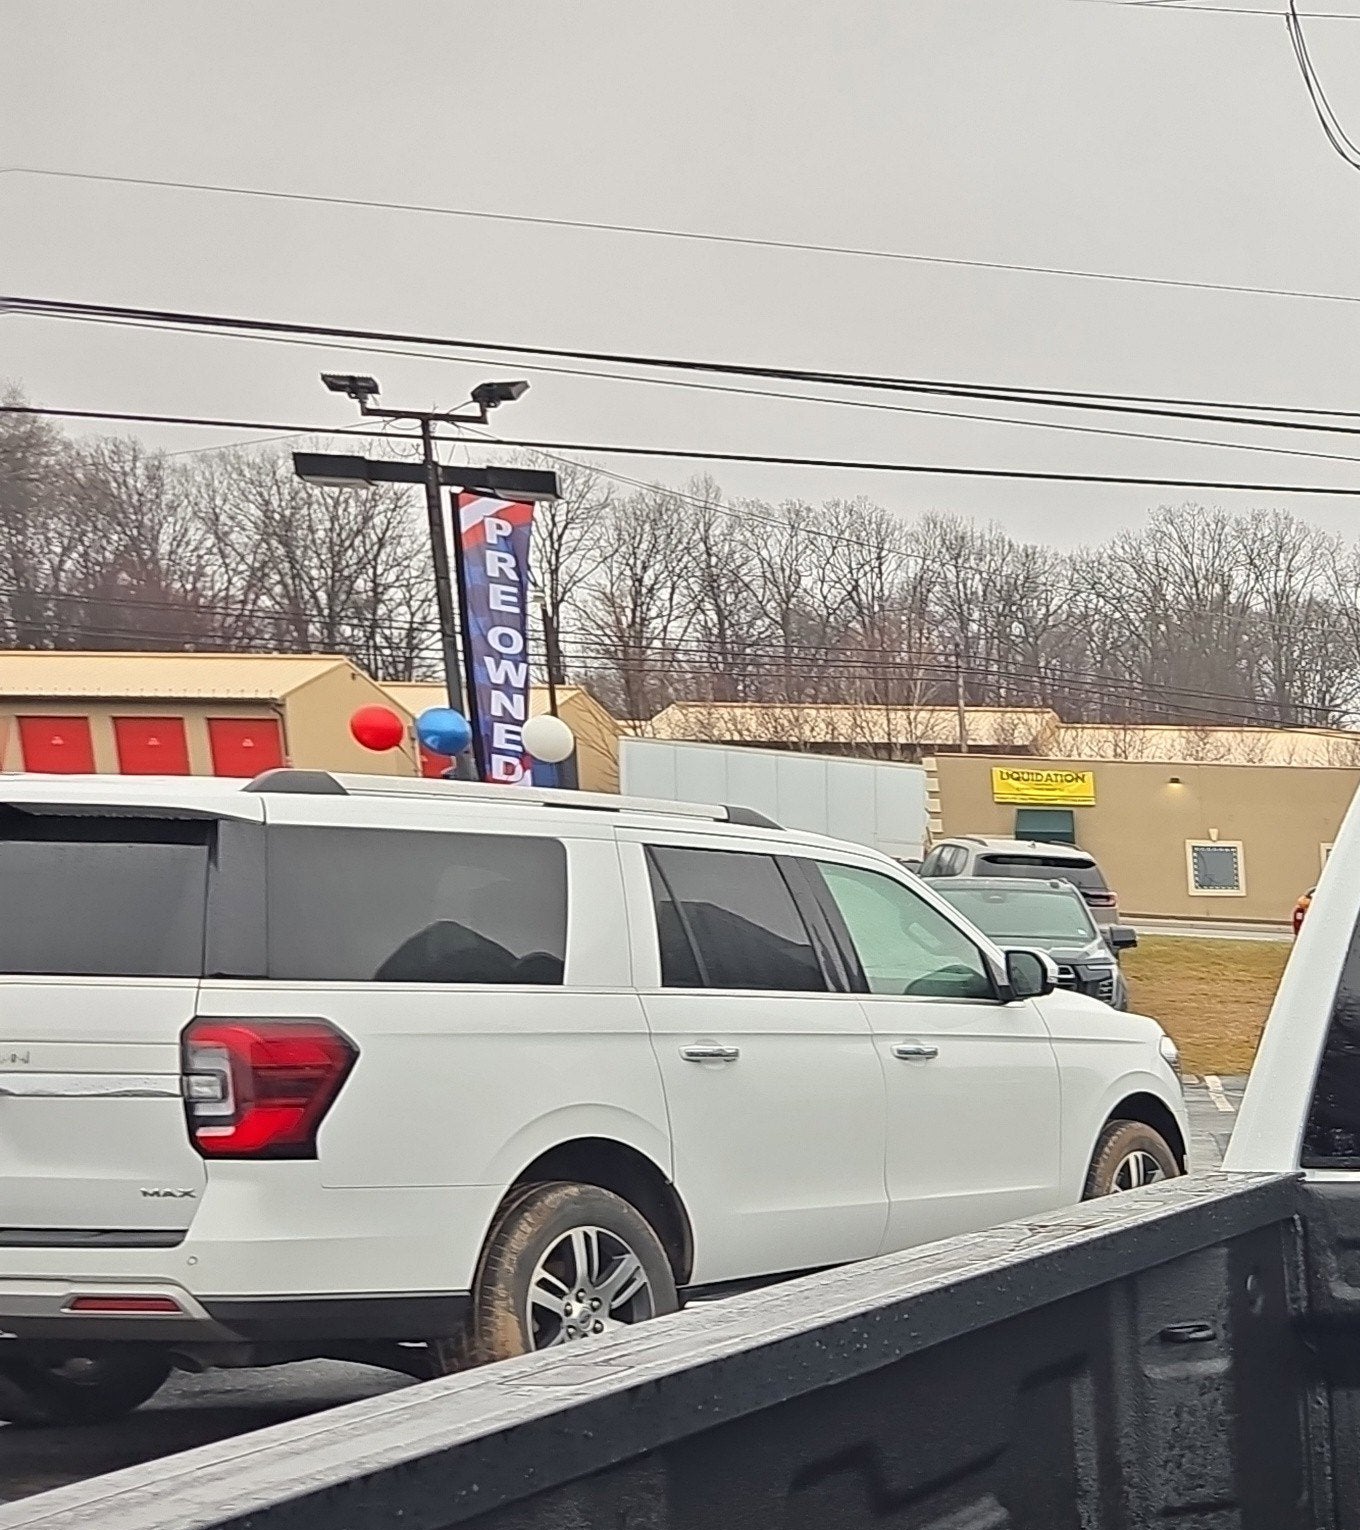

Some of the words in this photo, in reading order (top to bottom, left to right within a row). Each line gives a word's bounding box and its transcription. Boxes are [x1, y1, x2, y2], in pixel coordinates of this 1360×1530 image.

[484, 517, 520, 614] PRE
[483, 625, 528, 783] OWNED
[999, 770, 1086, 783] LIQUIDATION
[140, 1187, 197, 1199] MAX
